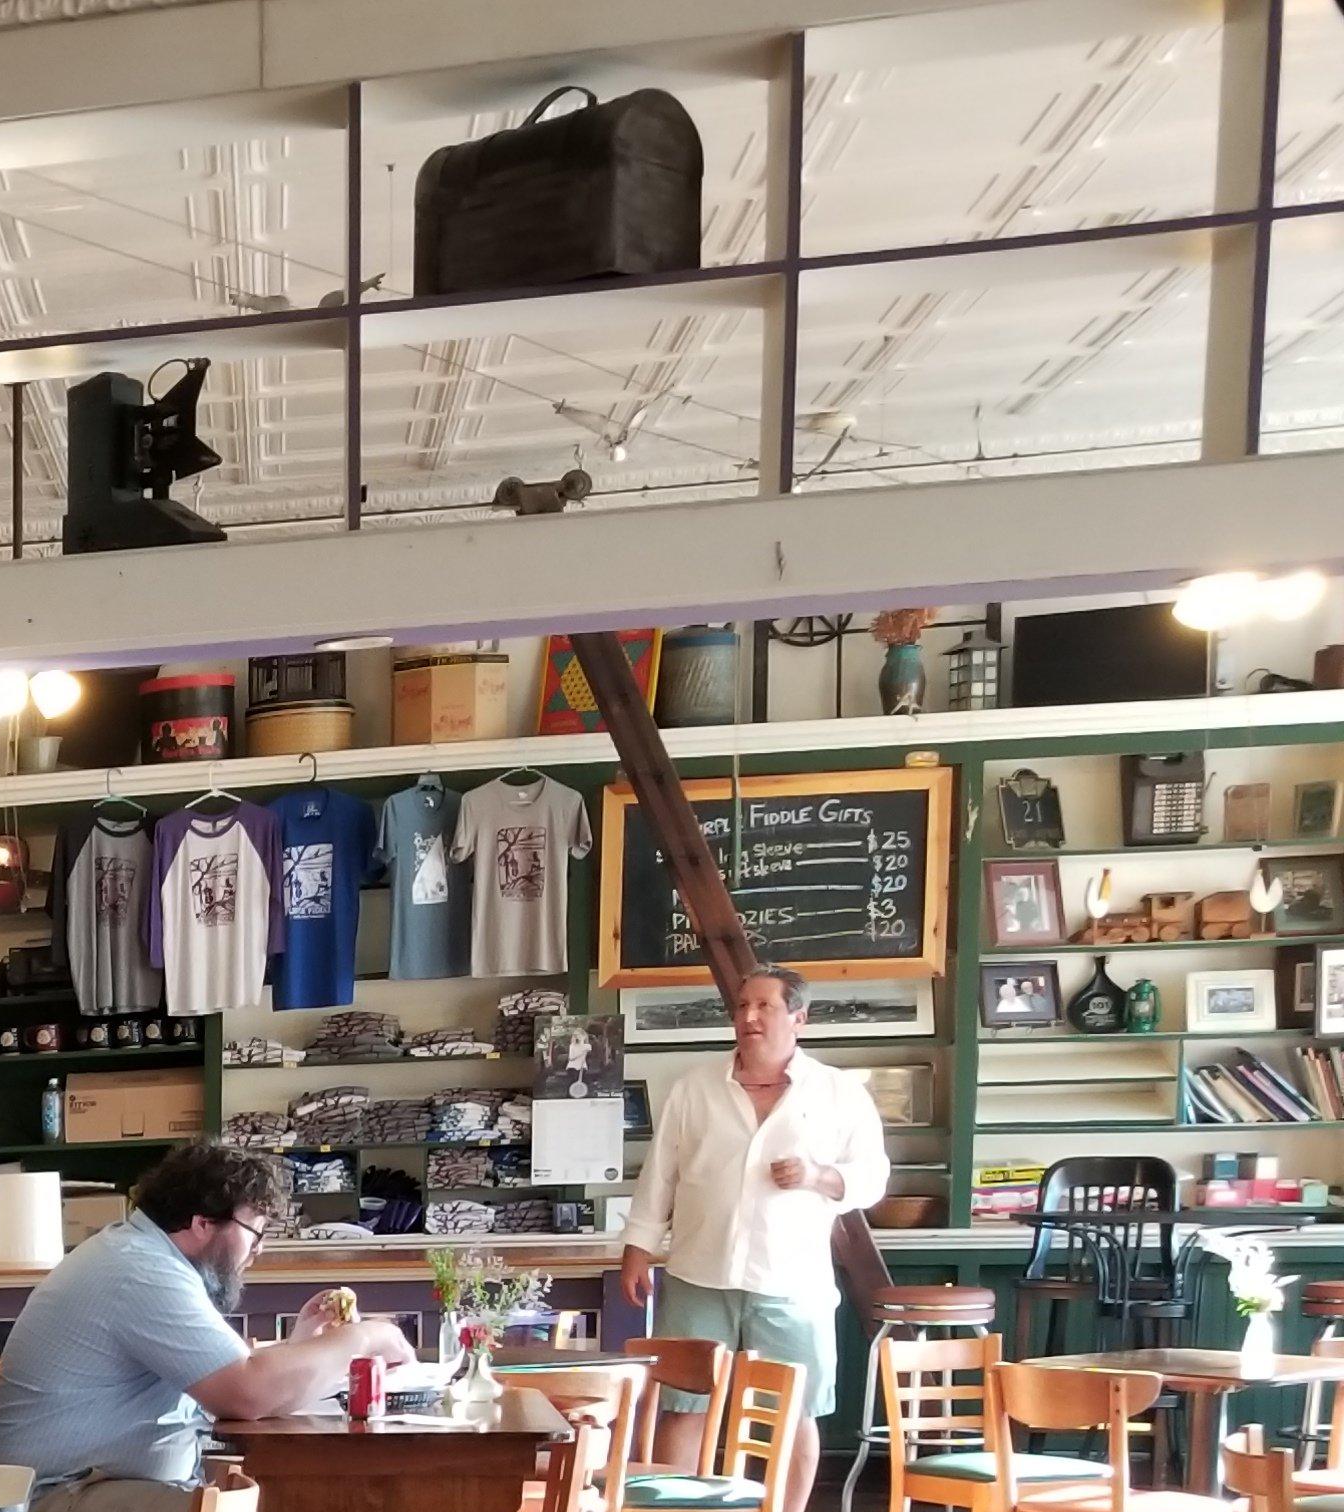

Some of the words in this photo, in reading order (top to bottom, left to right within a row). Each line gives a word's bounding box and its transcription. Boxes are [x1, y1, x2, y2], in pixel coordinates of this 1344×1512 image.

[749, 801, 814, 829] FIDDLE
[817, 798, 874, 826] GIFTS
[1022, 800, 1043, 823] 21
[866, 828, 912, 854] $25
[872, 854, 909, 873] $20
[871, 873, 908, 899] $20
[734, 906, 796, 926] OZIES
[866, 897, 897, 920] $3
[665, 933, 701, 955] BAL
[864, 919, 906, 943] $20
